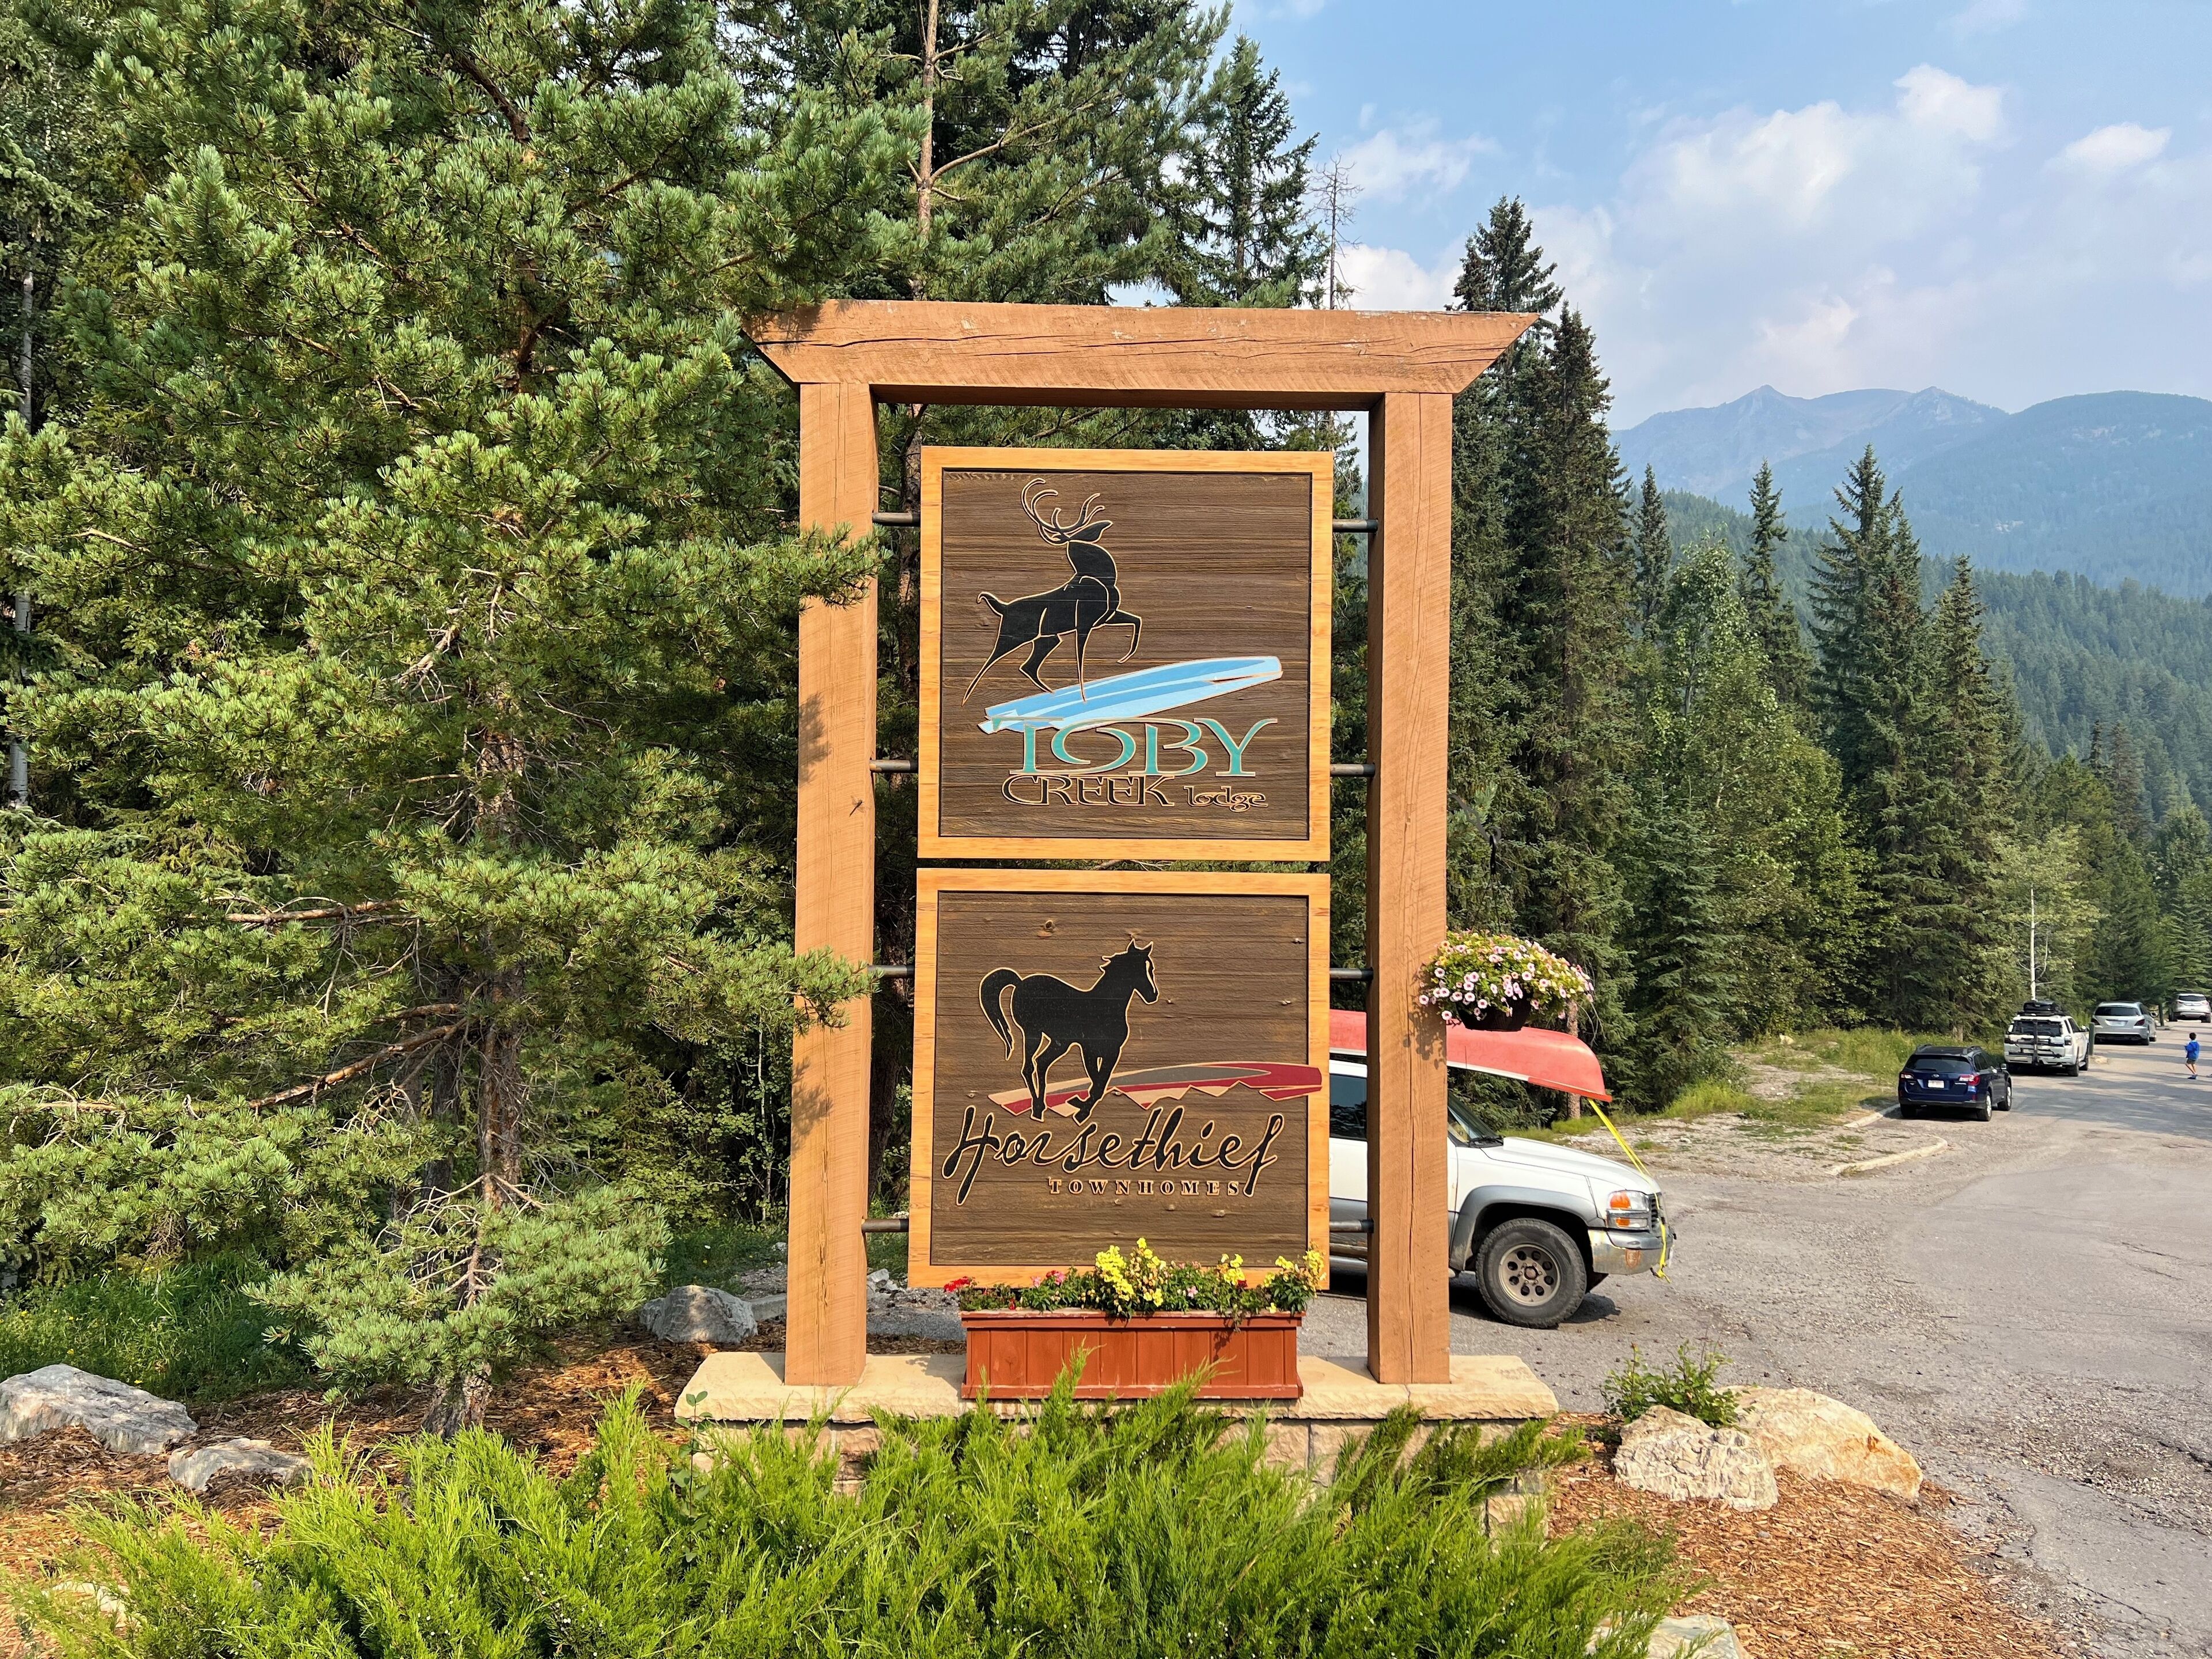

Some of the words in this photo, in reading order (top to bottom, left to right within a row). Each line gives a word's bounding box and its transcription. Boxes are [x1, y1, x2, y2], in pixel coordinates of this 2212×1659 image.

[991, 716, 1278, 778] TOBY
[1001, 774, 1175, 807] CREEK
[1183, 785, 1268, 813] lodge
[941, 1104, 1285, 1206] Horsethief
[1047, 1177, 1240, 1196] TOWNHOMES
